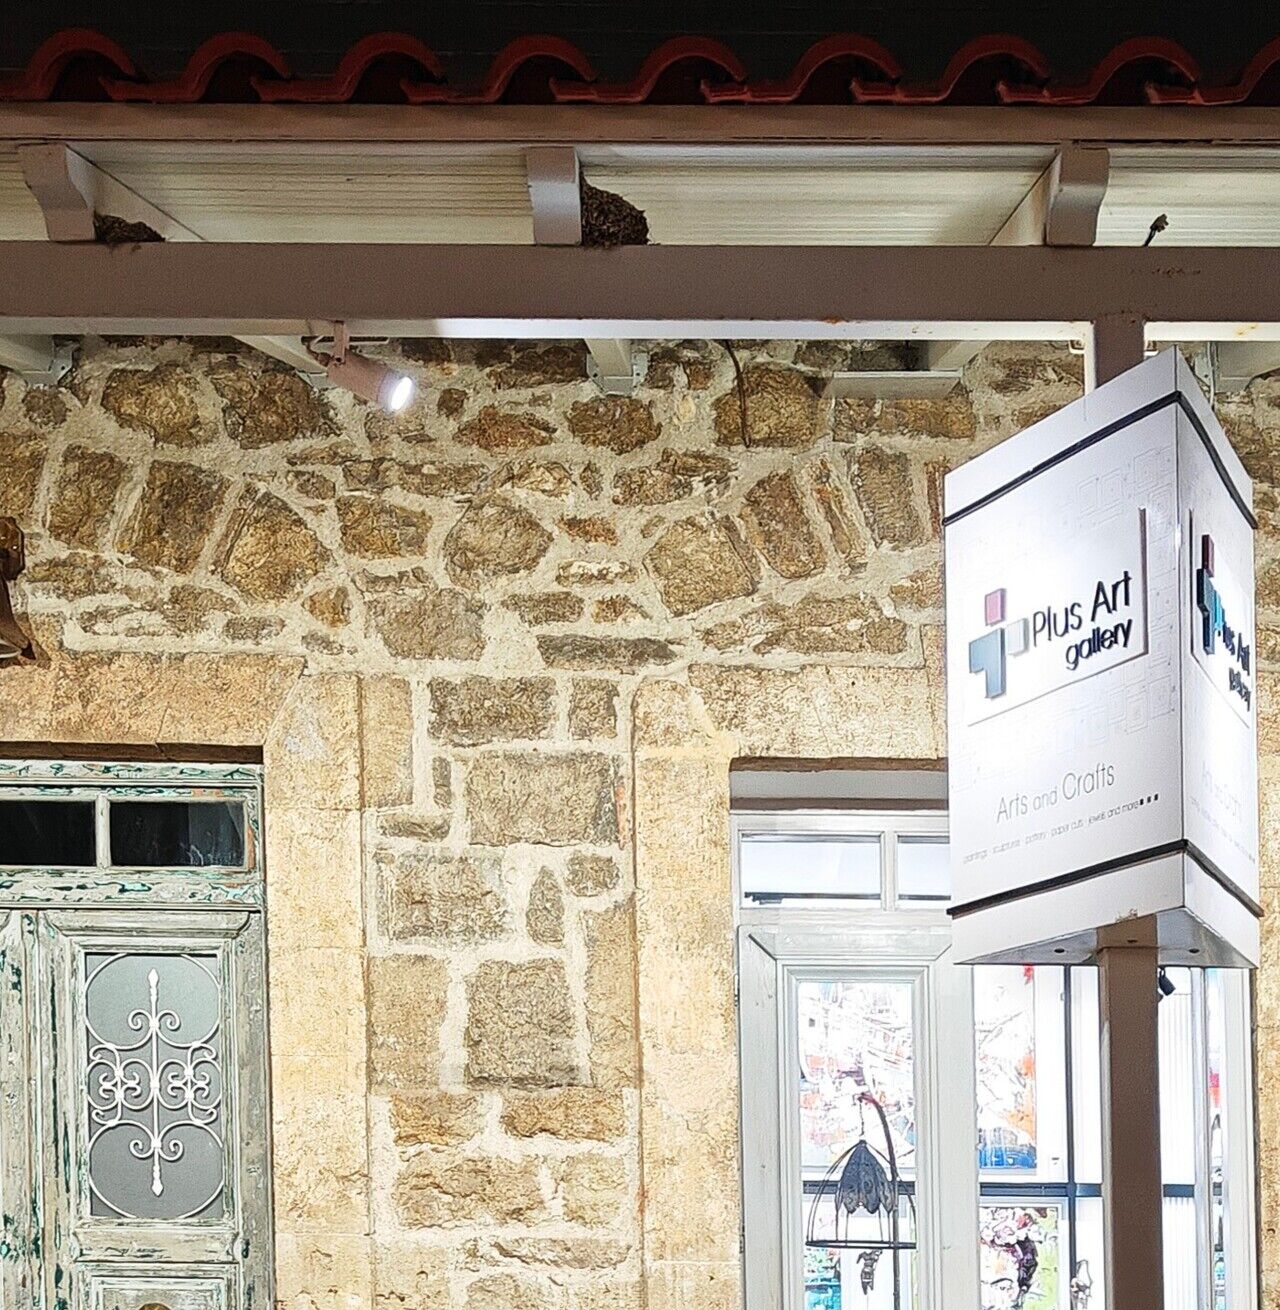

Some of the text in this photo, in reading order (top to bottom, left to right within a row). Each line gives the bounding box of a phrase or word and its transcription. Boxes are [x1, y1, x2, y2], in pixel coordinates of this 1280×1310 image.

[1033, 570, 1132, 647] Plus Art
[1065, 619, 1133, 671] gallery
[996, 763, 1115, 823] Arts and Crafts
